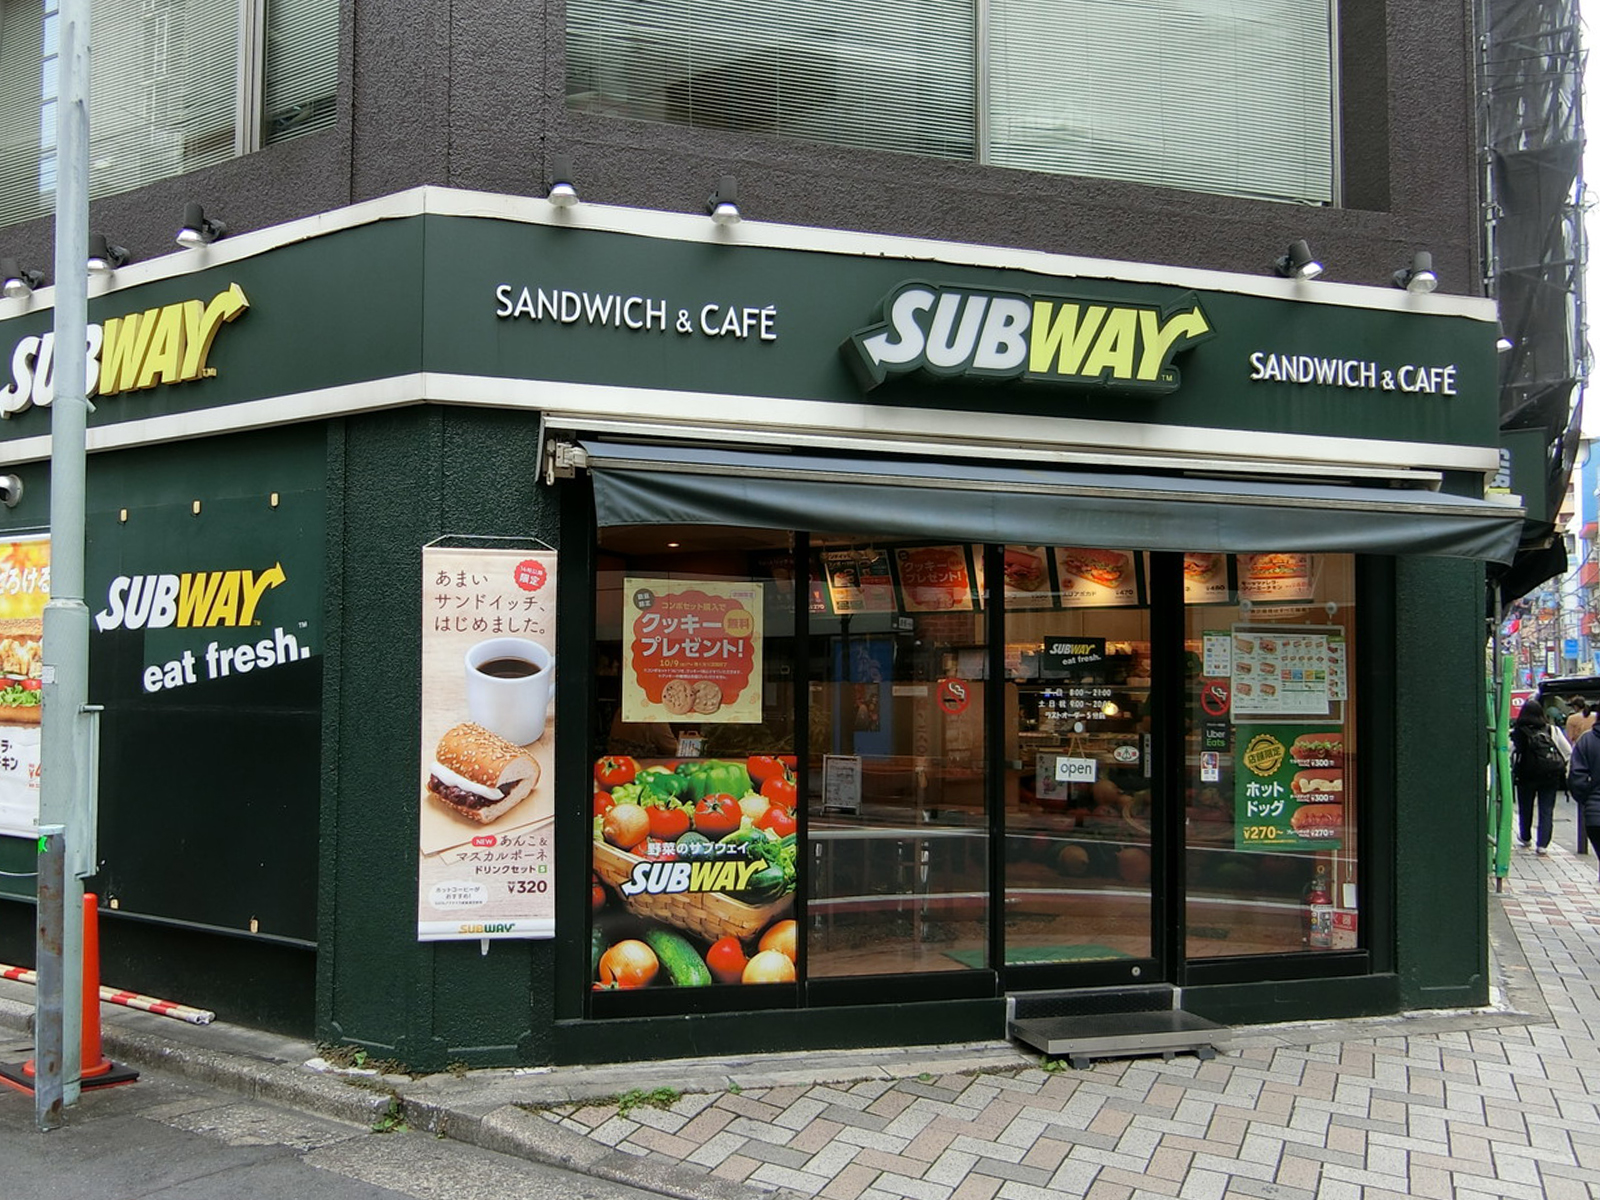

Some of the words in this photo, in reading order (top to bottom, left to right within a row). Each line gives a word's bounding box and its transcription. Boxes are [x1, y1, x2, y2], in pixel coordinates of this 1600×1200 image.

[496, 284, 667, 331] SANDWICH
[676, 309, 693, 333] &
[700, 304, 777, 341] CAFÉ
[863, 289, 1209, 381] SUBWAY
[1250, 352, 1376, 389] SANDWICH
[1380, 370, 1396, 391] &
[1398, 364, 1457, 396] CAFÉ
[435, 570, 488, 588] あまい
[95, 562, 287, 633] SUBWAY
[435, 594, 545, 612] サンドイッチ、
[435, 616, 545, 635] はじめました。
[641, 613, 722, 634] クッキー
[1050, 643, 1096, 655] SUBWAY
[144, 651, 198, 693] eat
[205, 627, 310, 680] fresh.
[1206, 730, 1226, 738] Uber
[1206, 738, 1226, 747] Eats
[0, 756, 18, 770] キン
[1060, 763, 1092, 778] open
[1246, 781, 1285, 797] ホット
[1247, 800, 1285, 817] ドッグ
[475, 836, 493, 845] NEW
[647, 841, 749, 856] 野菜のサブウェイ
[456, 849, 548, 862] マスカルポーネ
[475, 865, 536, 874] ドリンクセット
[621, 858, 769, 897] SUBWAY
[507, 880, 548, 893] ¥320
[458, 923, 516, 934] SUBWAY
